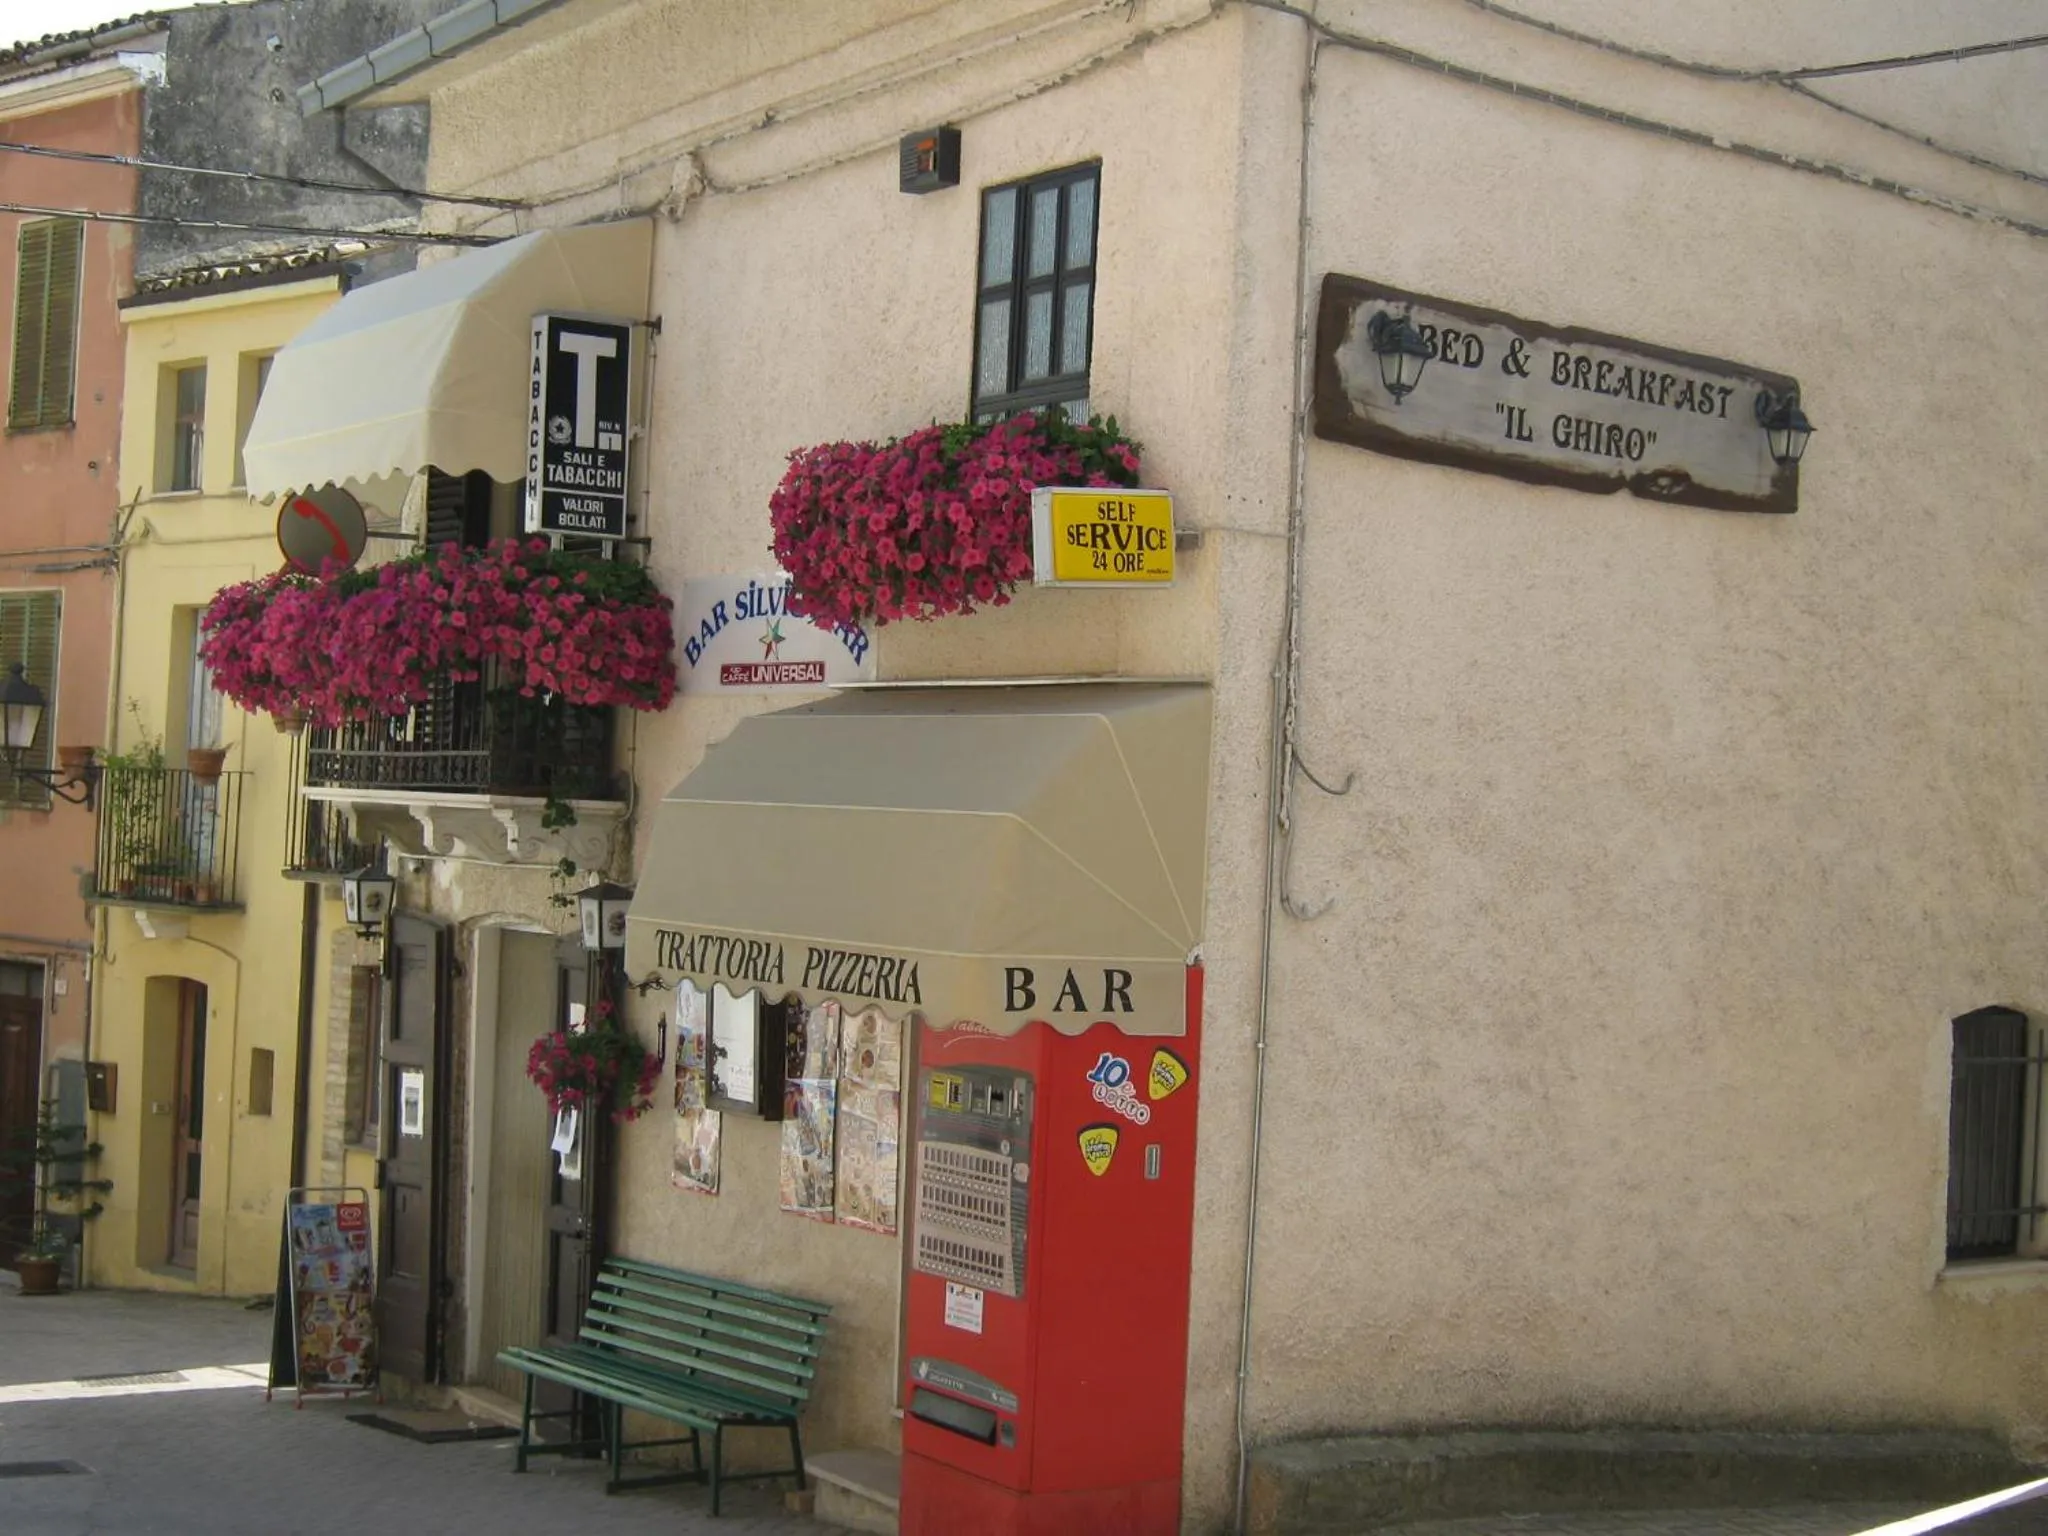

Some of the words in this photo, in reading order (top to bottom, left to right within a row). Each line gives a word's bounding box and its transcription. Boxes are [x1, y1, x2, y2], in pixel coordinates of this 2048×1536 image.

[1418, 324, 1484, 368] BED
[1501, 337, 1531, 378] &
[1551, 351, 1736, 418] BREAKFAST
[559, 331, 617, 449] T
[528, 331, 542, 521] TABACCHI
[1496, 402, 1533, 442] "IL
[1552, 414, 1657, 462] GHIRO"
[563, 451, 592, 466] SALI
[598, 455, 606, 467] E
[547, 463, 622, 489] TABACCHI
[558, 513, 606, 529] BOLLATI
[562, 497, 604, 514] VALORI
[1098, 501, 1136, 522] SELF
[1067, 523, 1167, 551] SERVICE
[1093, 551, 1107, 571] 24
[1114, 553, 1144, 573] ORE
[685, 601, 729, 668] BAR
[751, 665, 822, 682] UNIVERSAL
[656, 929, 785, 984] TRATTORIA
[801, 947, 922, 1004] PIZZERIA
[1004, 967, 1135, 1013] BAR
[1087, 1054, 1129, 1088] 10
